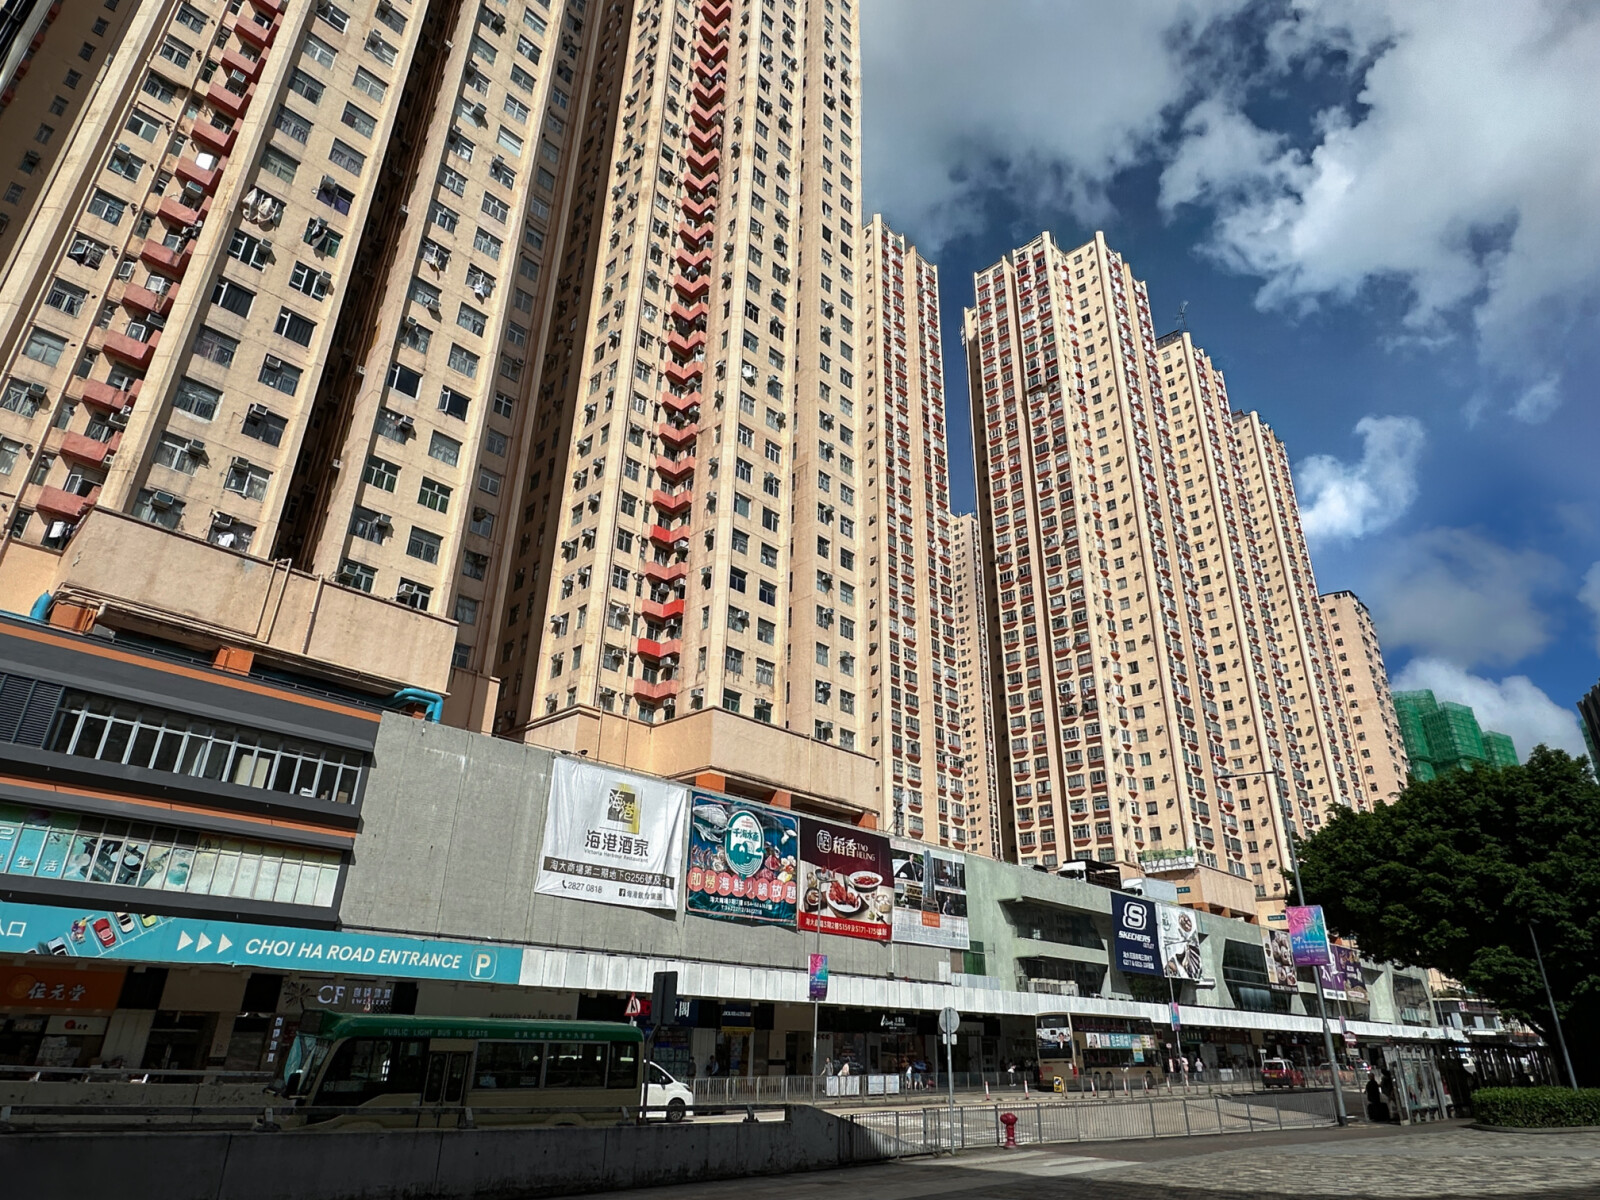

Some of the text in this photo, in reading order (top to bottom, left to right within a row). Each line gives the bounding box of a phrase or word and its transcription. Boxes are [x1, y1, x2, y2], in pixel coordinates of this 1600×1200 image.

[585, 829, 649, 857] 海港酒家
[832, 836, 857, 858] 稻香
[857, 843, 868, 852] TAO
[856, 852, 876, 862] HEUNG
[568, 881, 602, 893] 2827 0818
[1119, 931, 1151, 943] SKECHERS
[245, 938, 492, 976] CHOI HA ROAD ENTRANCE P
[317, 985, 345, 1004] CF
[383, 1028, 409, 1037] PUBLIC
[414, 1029, 433, 1037] LIGHT
[437, 1029, 451, 1037] BUS
[467, 1030, 489, 1038] SEATS
